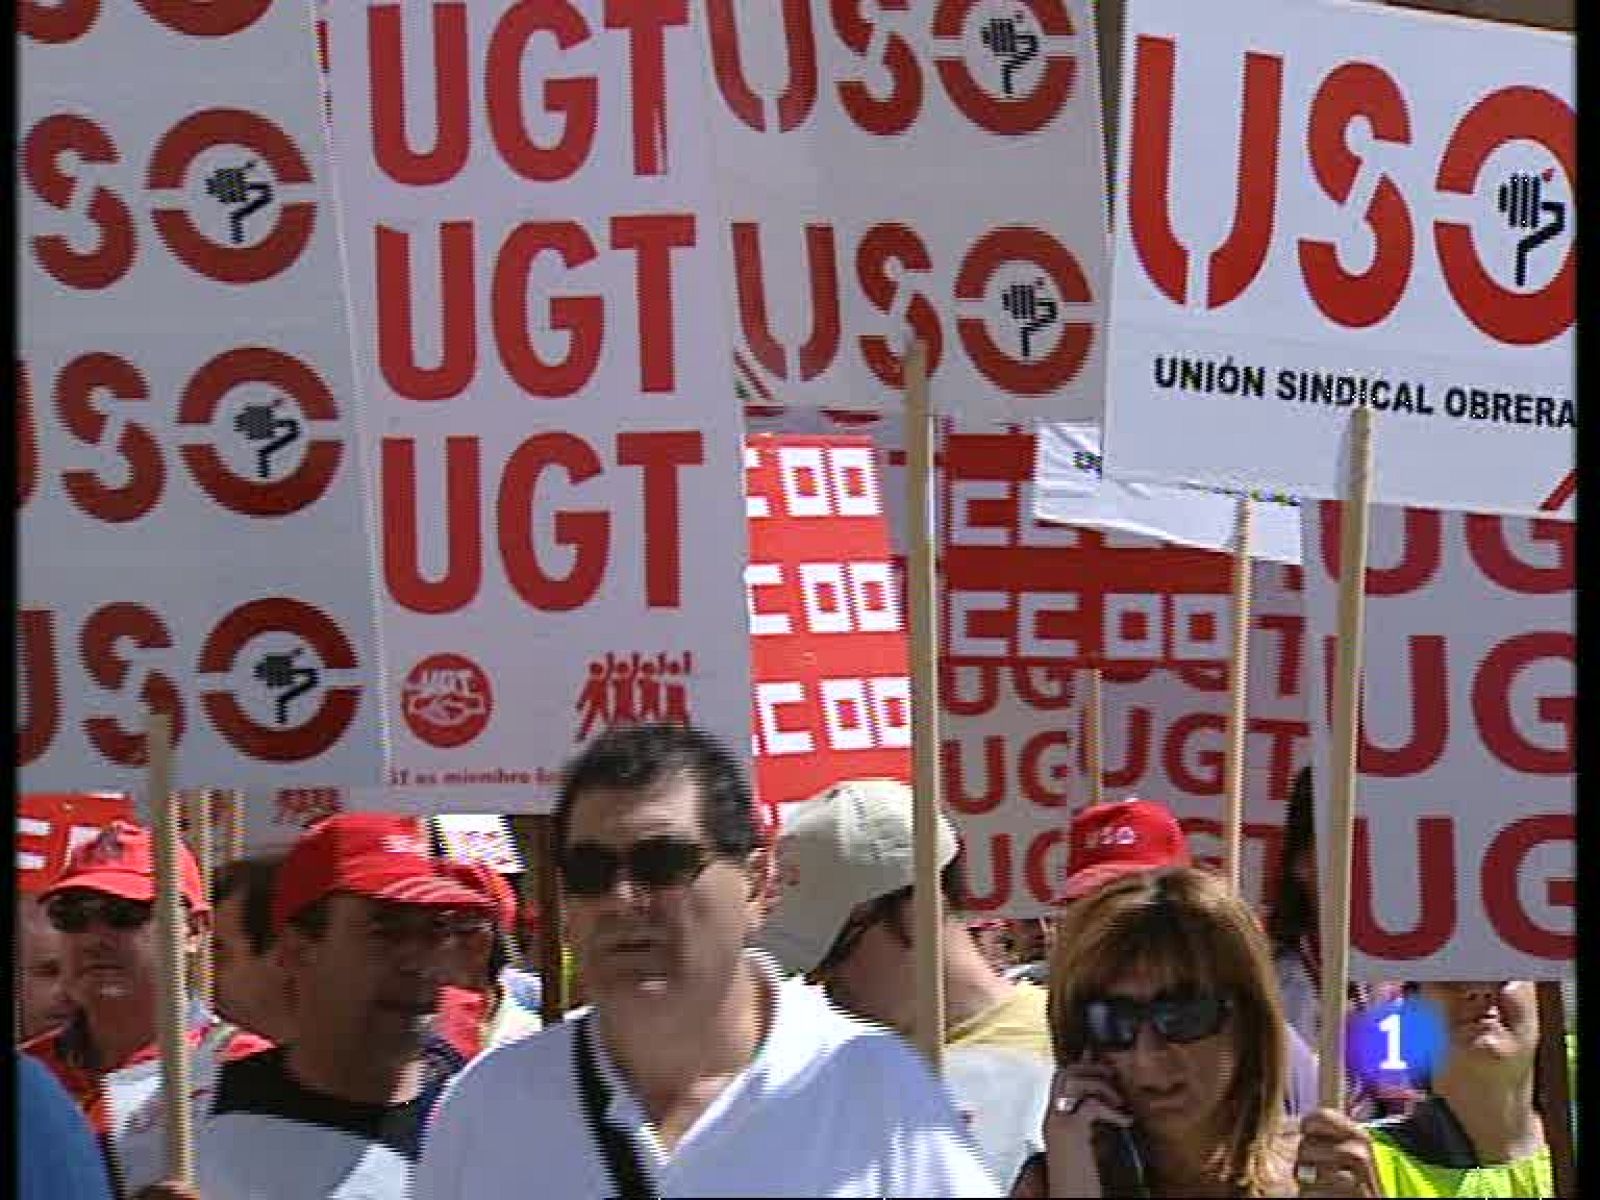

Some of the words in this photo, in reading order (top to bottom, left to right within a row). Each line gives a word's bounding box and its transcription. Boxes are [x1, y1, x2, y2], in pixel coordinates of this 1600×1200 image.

[367, 0, 691, 186] UGT
[706, 0, 1078, 137] USO
[1128, 33, 1576, 347] USO
[375, 214, 697, 400] UGT
[731, 222, 1095, 396] USO
[1154, 357, 1266, 398] UNIÓN
[1277, 369, 1435, 416] SINDICAL
[1444, 386, 1577, 429] OBRERA
[17, 346, 345, 522] SO
[380, 430, 705, 613] UGT
